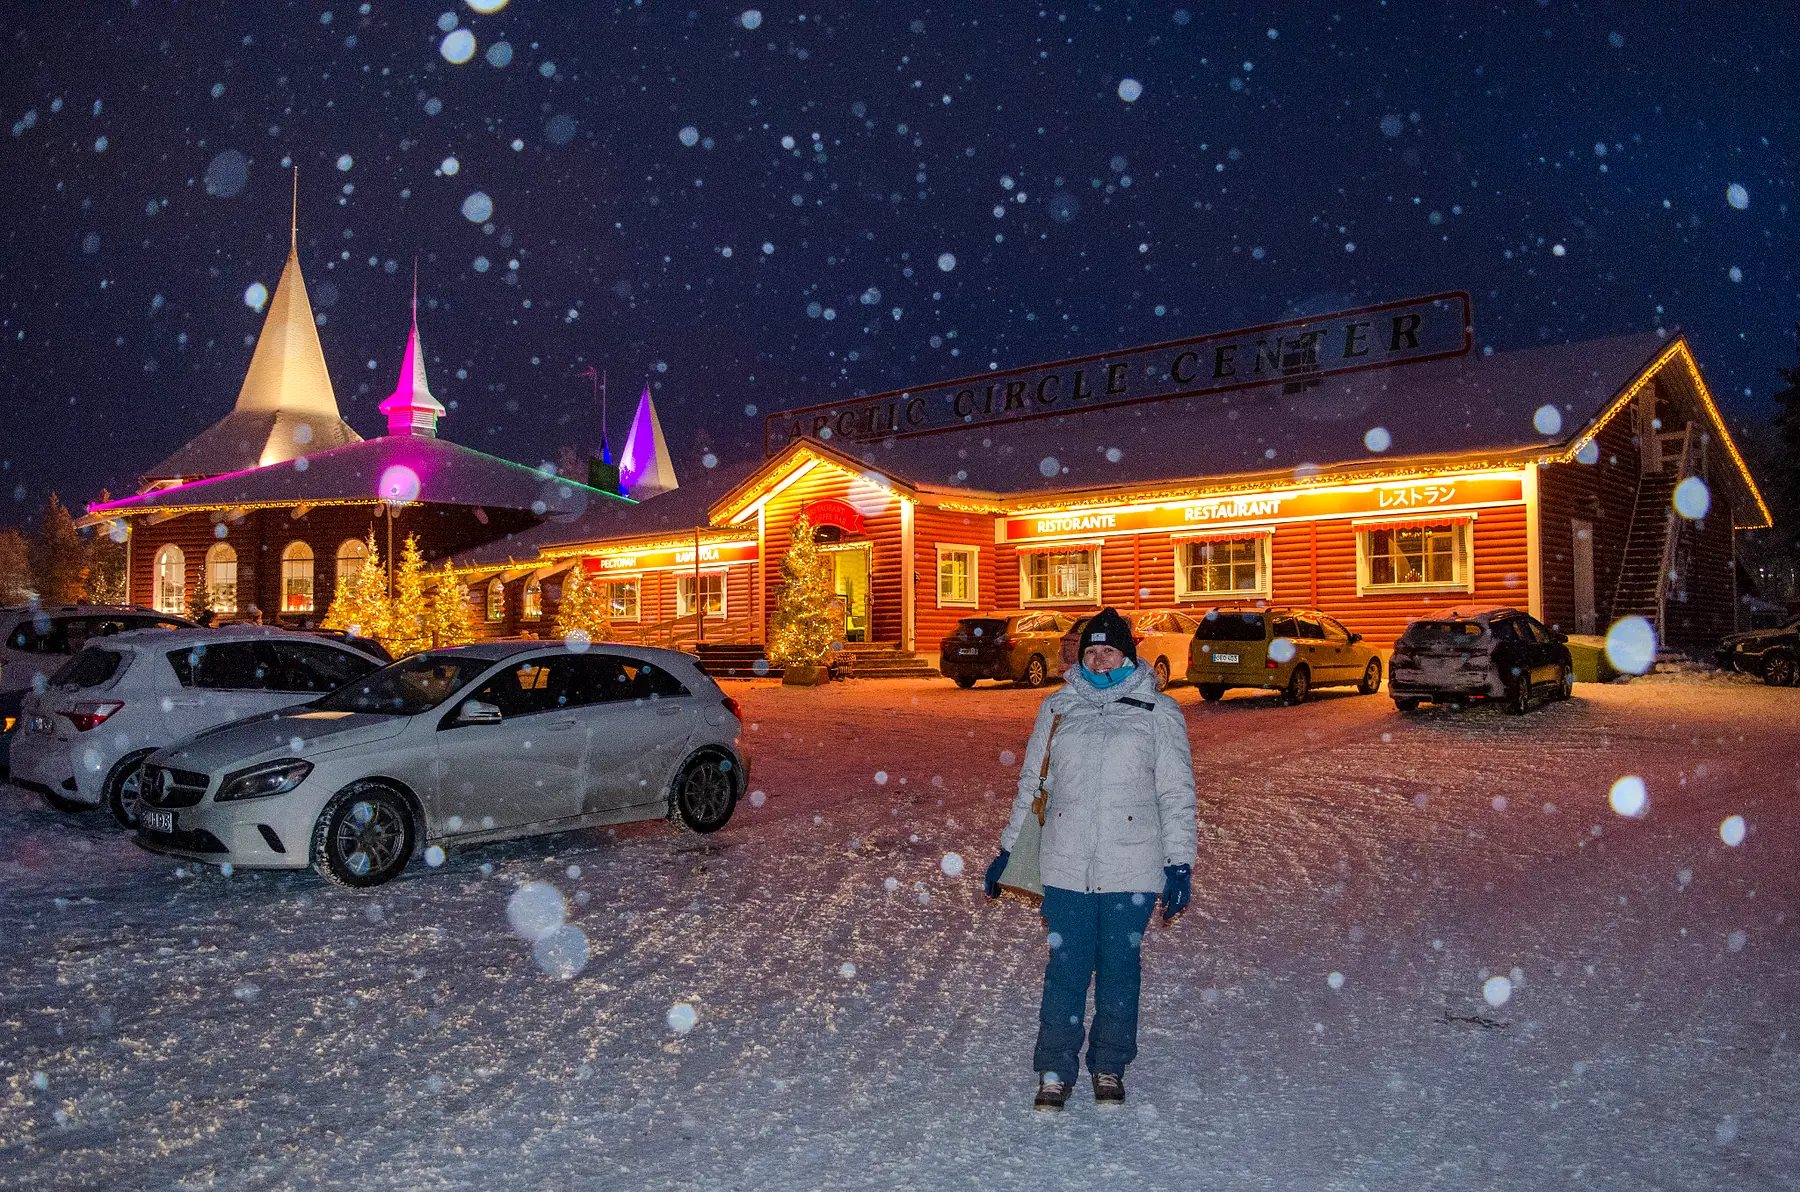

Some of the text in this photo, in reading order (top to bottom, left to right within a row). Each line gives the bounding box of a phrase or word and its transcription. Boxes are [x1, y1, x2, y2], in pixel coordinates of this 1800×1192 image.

[786, 313, 1422, 445] ARCTIC CIRCLE CENTER
[1378, 487, 1456, 508] レストラン
[1184, 500, 1282, 521] RESTAURANT
[1037, 514, 1117, 533] RISTORANTE
